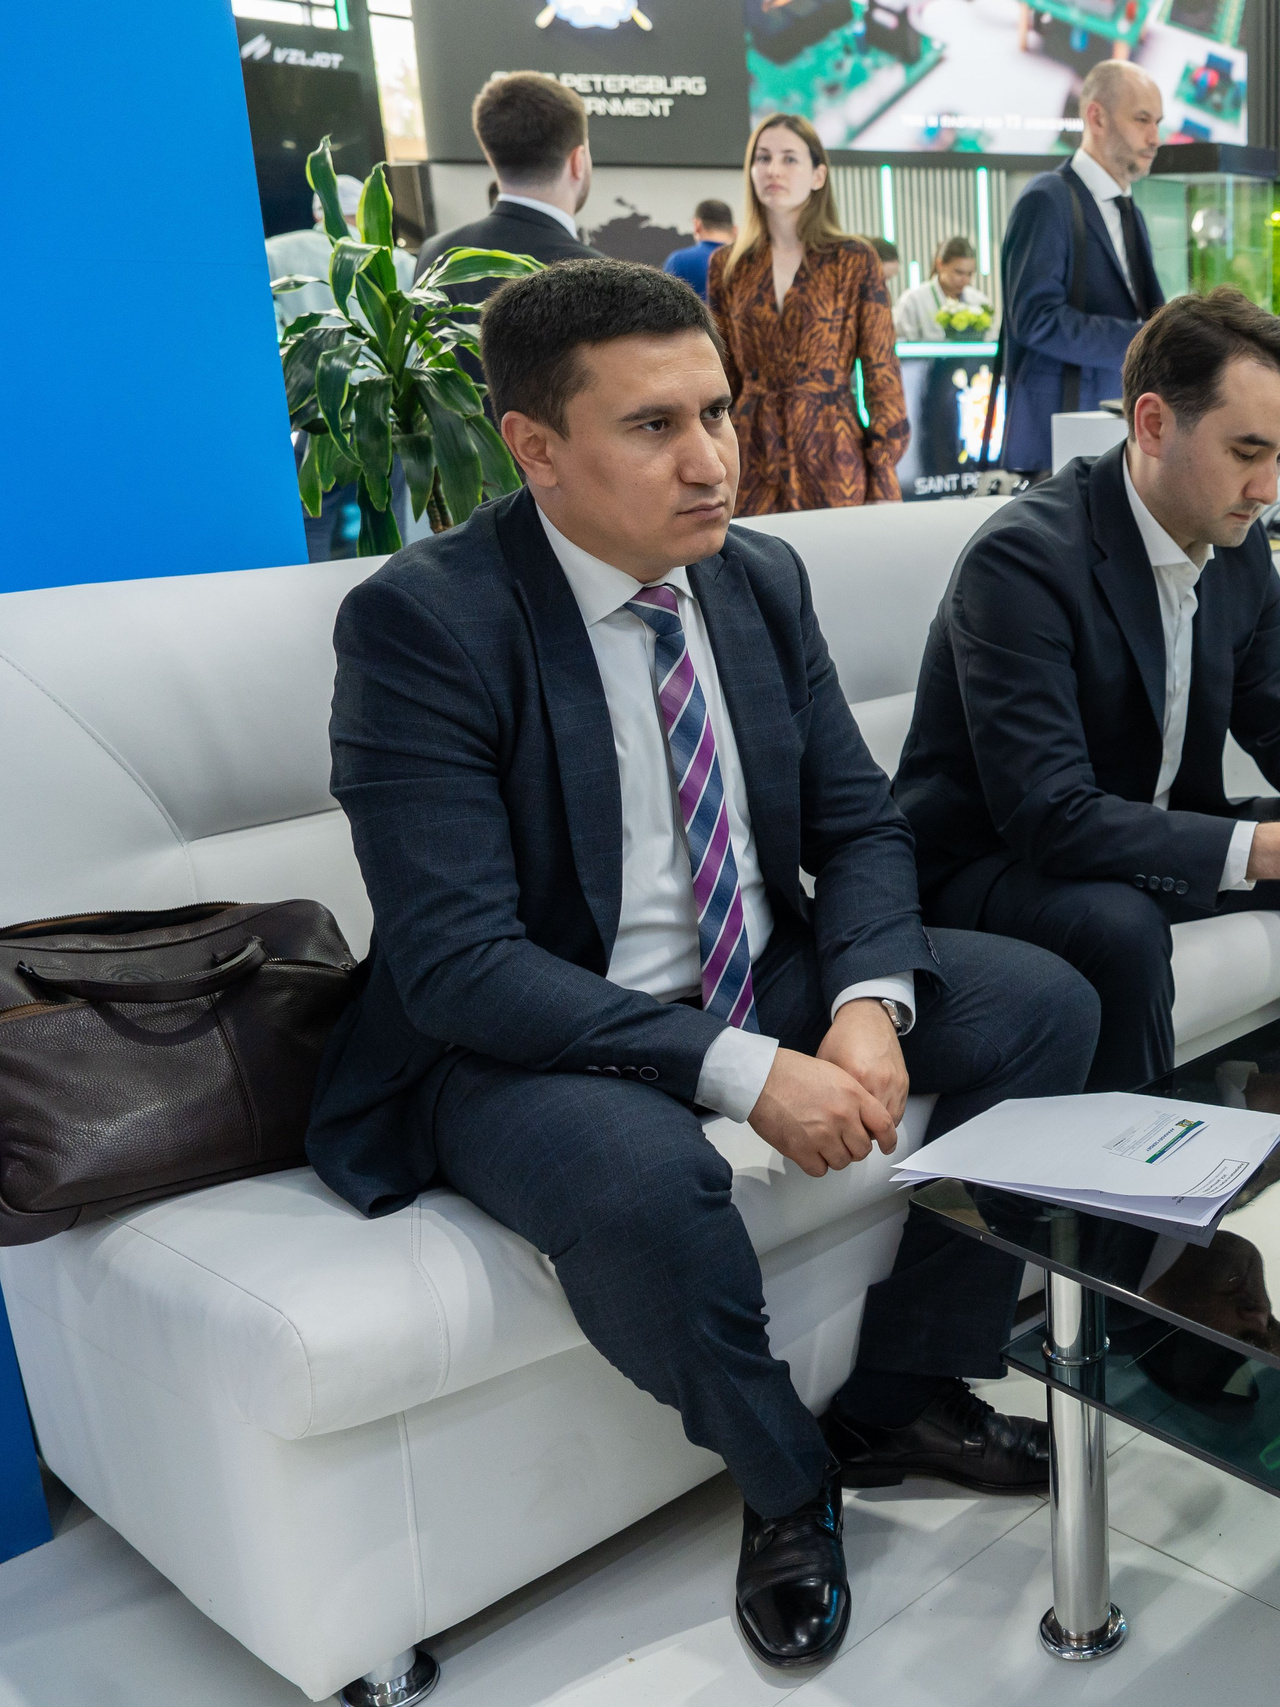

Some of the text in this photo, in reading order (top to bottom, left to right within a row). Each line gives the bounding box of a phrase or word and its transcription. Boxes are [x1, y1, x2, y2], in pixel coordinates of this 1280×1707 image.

[559, 72, 708, 96] PETERSBURG
[582, 96, 675, 118] RNMENT
[914, 473, 960, 495] SANT
